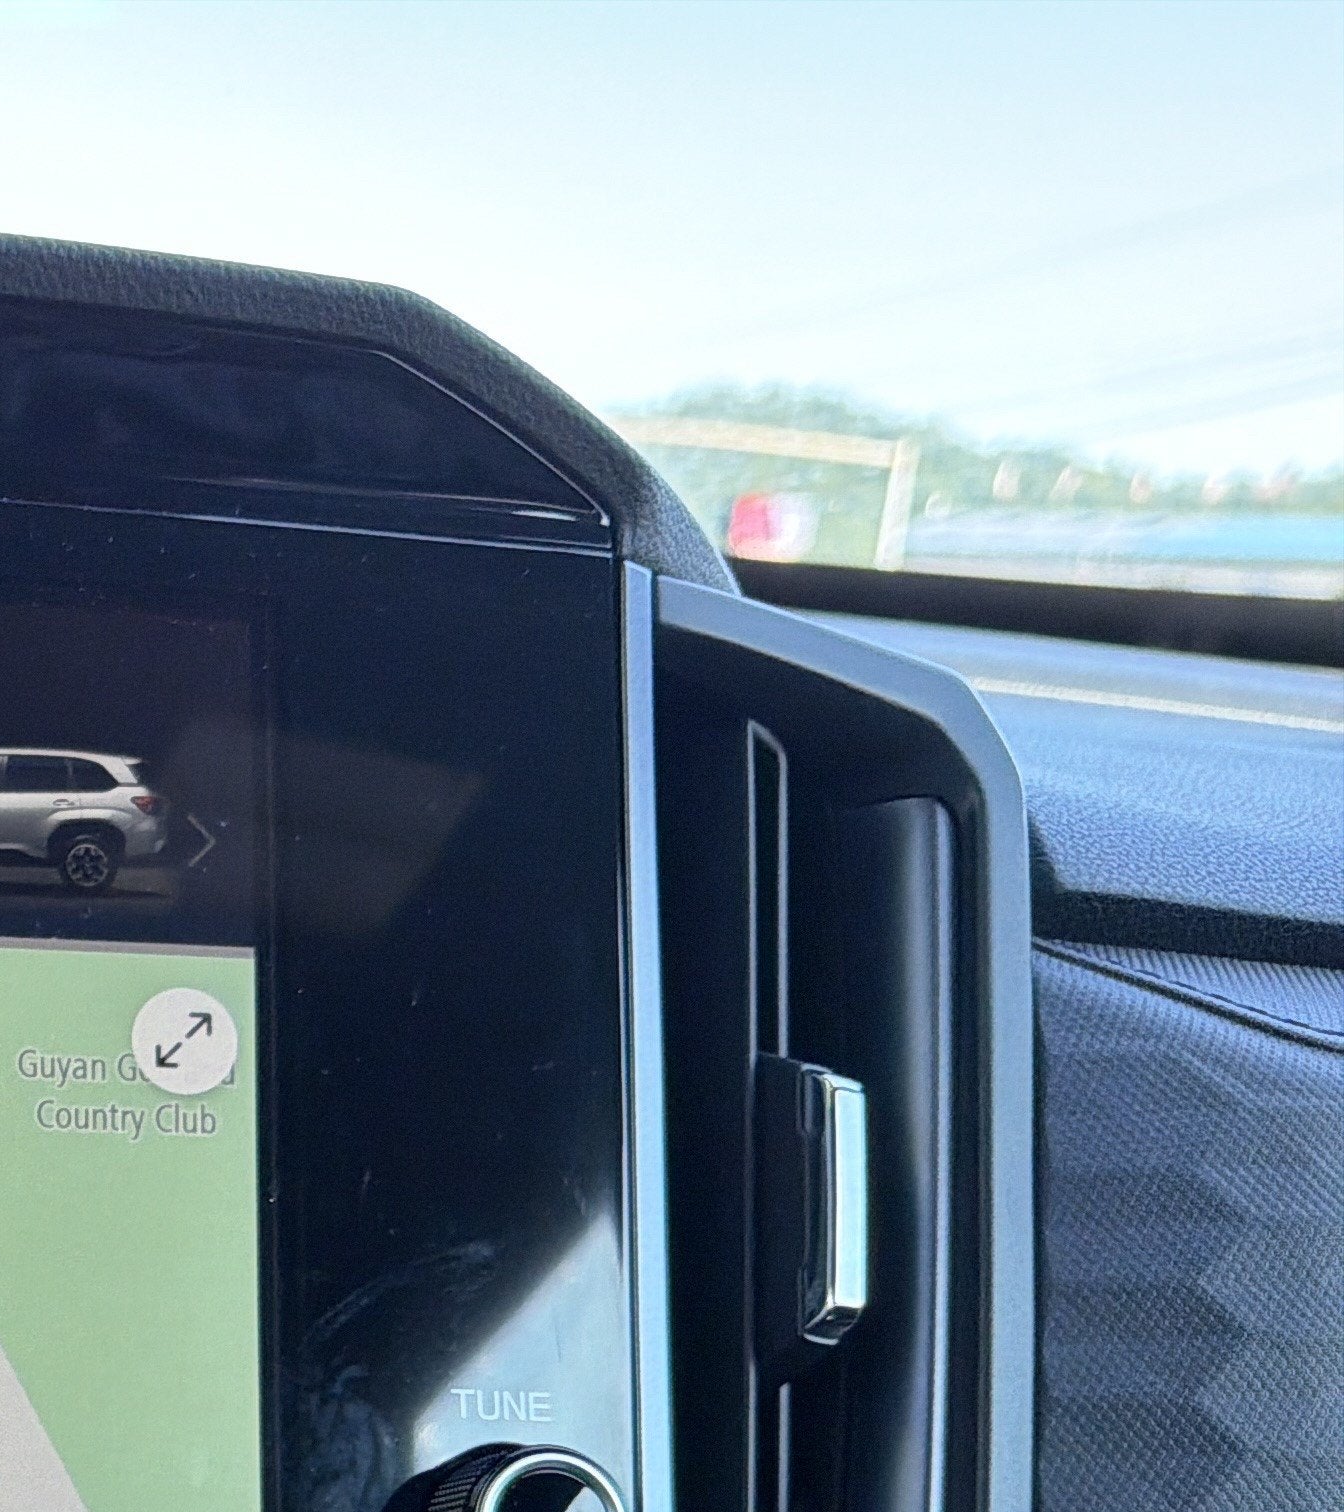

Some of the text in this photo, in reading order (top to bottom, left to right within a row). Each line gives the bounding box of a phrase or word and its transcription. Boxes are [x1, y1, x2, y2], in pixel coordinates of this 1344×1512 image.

[18, 1049, 106, 1088] Guyan
[37, 1100, 217, 1140] Country Club
[450, 1387, 555, 1422] TUNE
